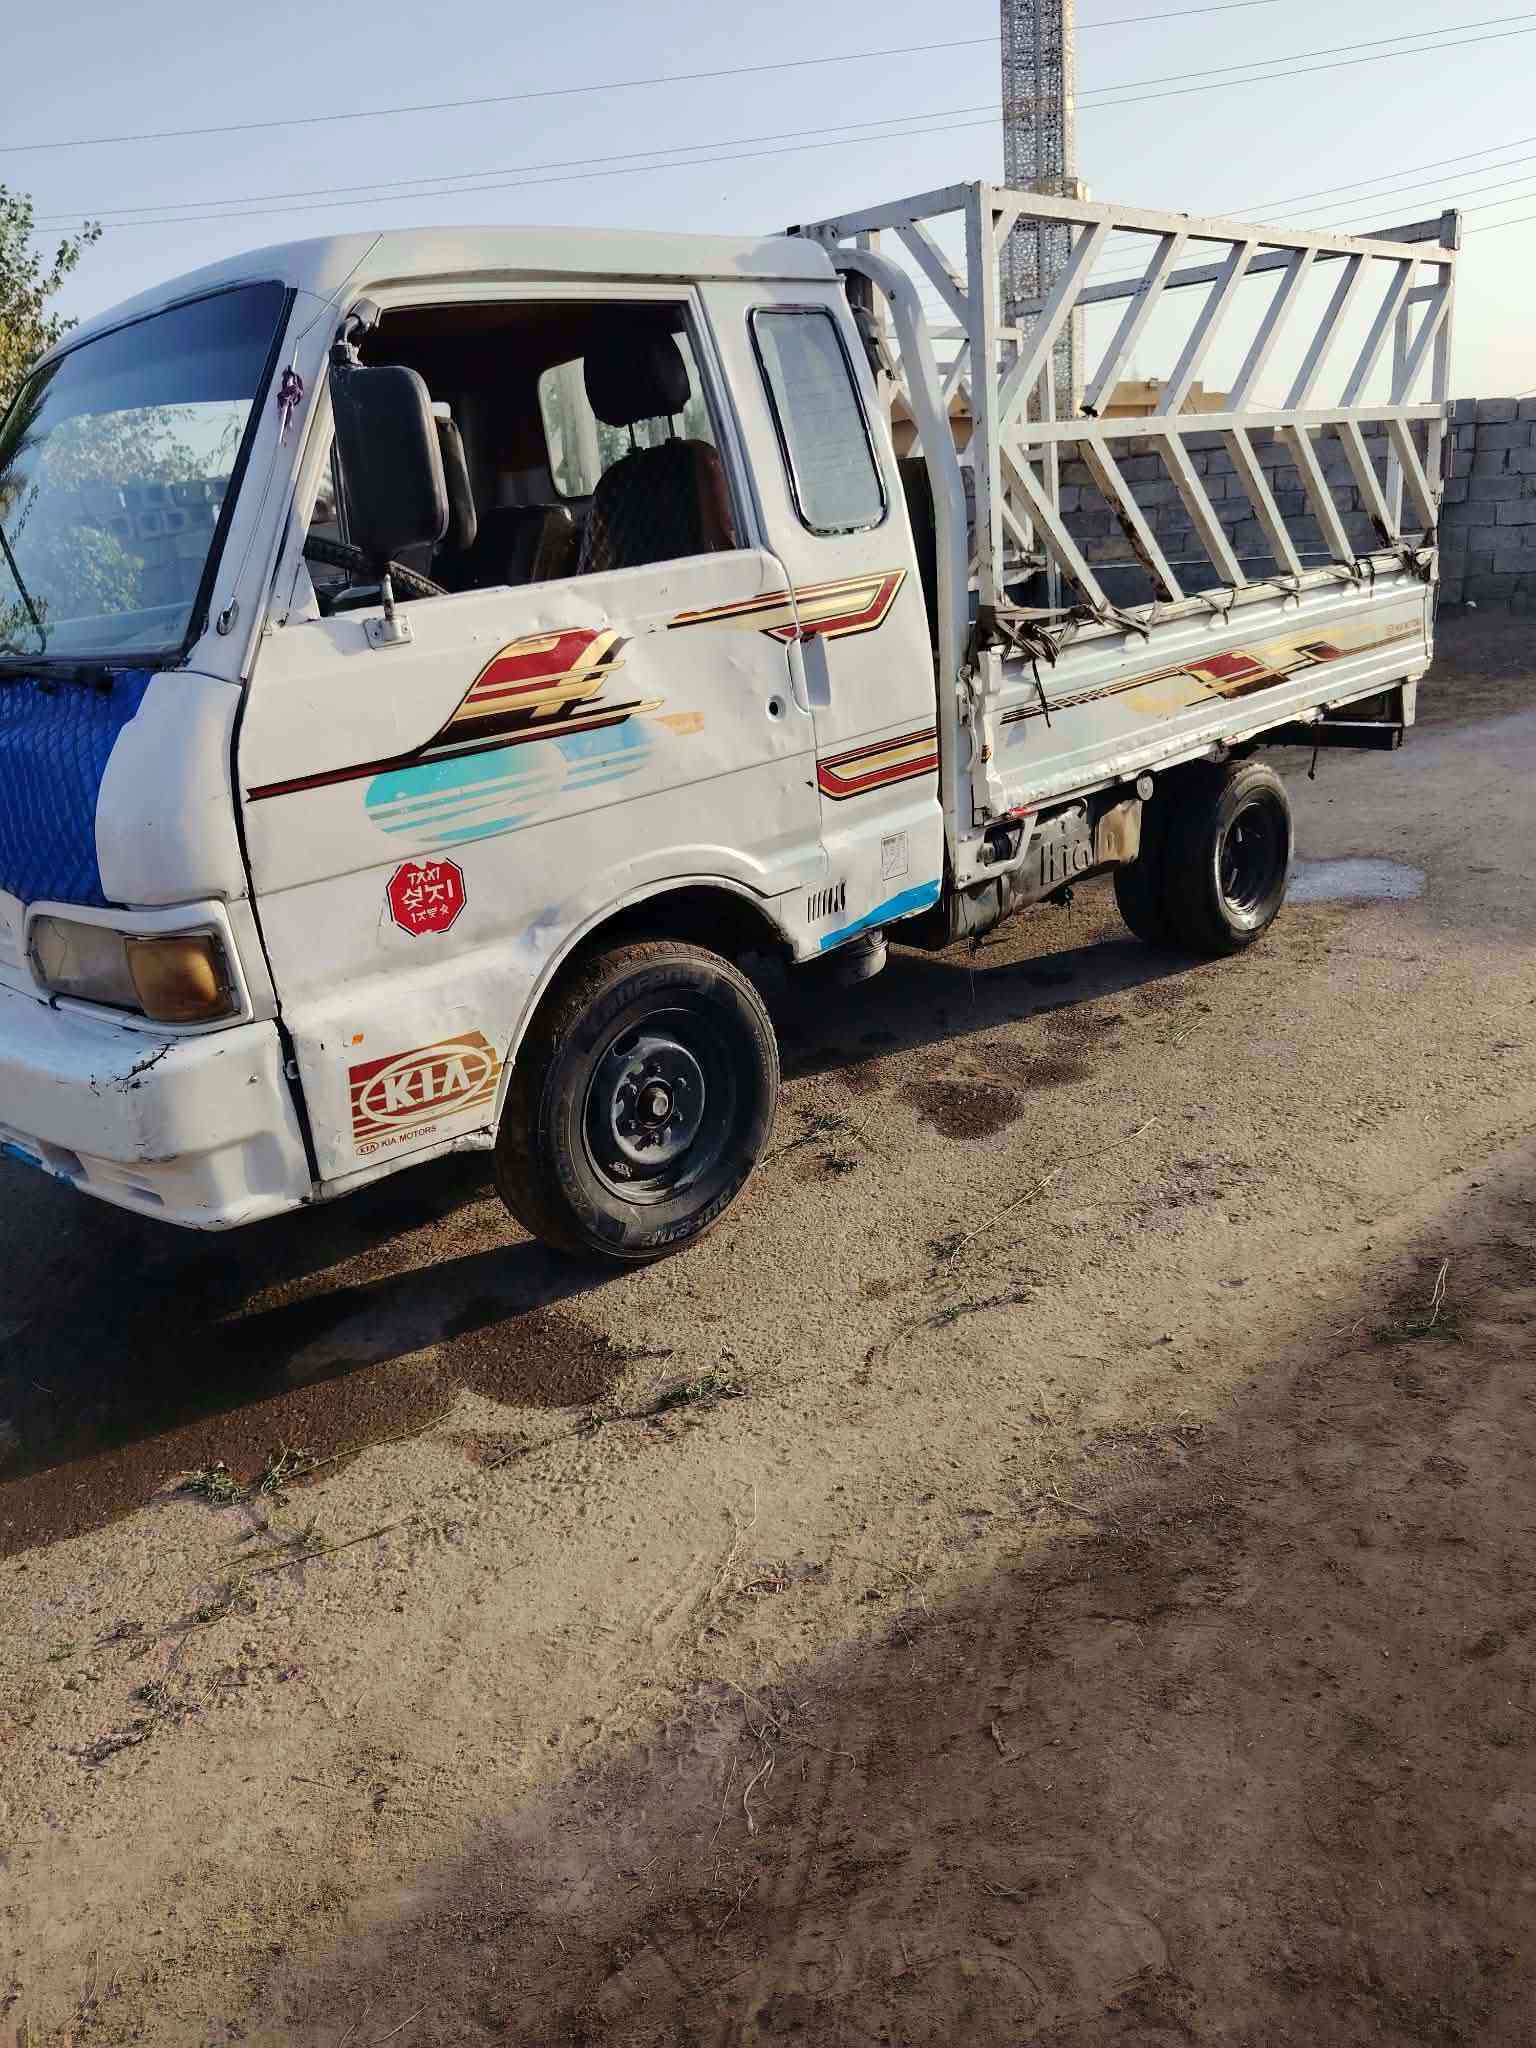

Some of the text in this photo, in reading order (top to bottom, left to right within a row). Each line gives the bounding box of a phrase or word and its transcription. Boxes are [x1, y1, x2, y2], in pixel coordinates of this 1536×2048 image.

[407, 866, 440, 887] TAXI
[383, 1058, 471, 1113] KIA
[399, 1126, 437, 1143] MOTORS
